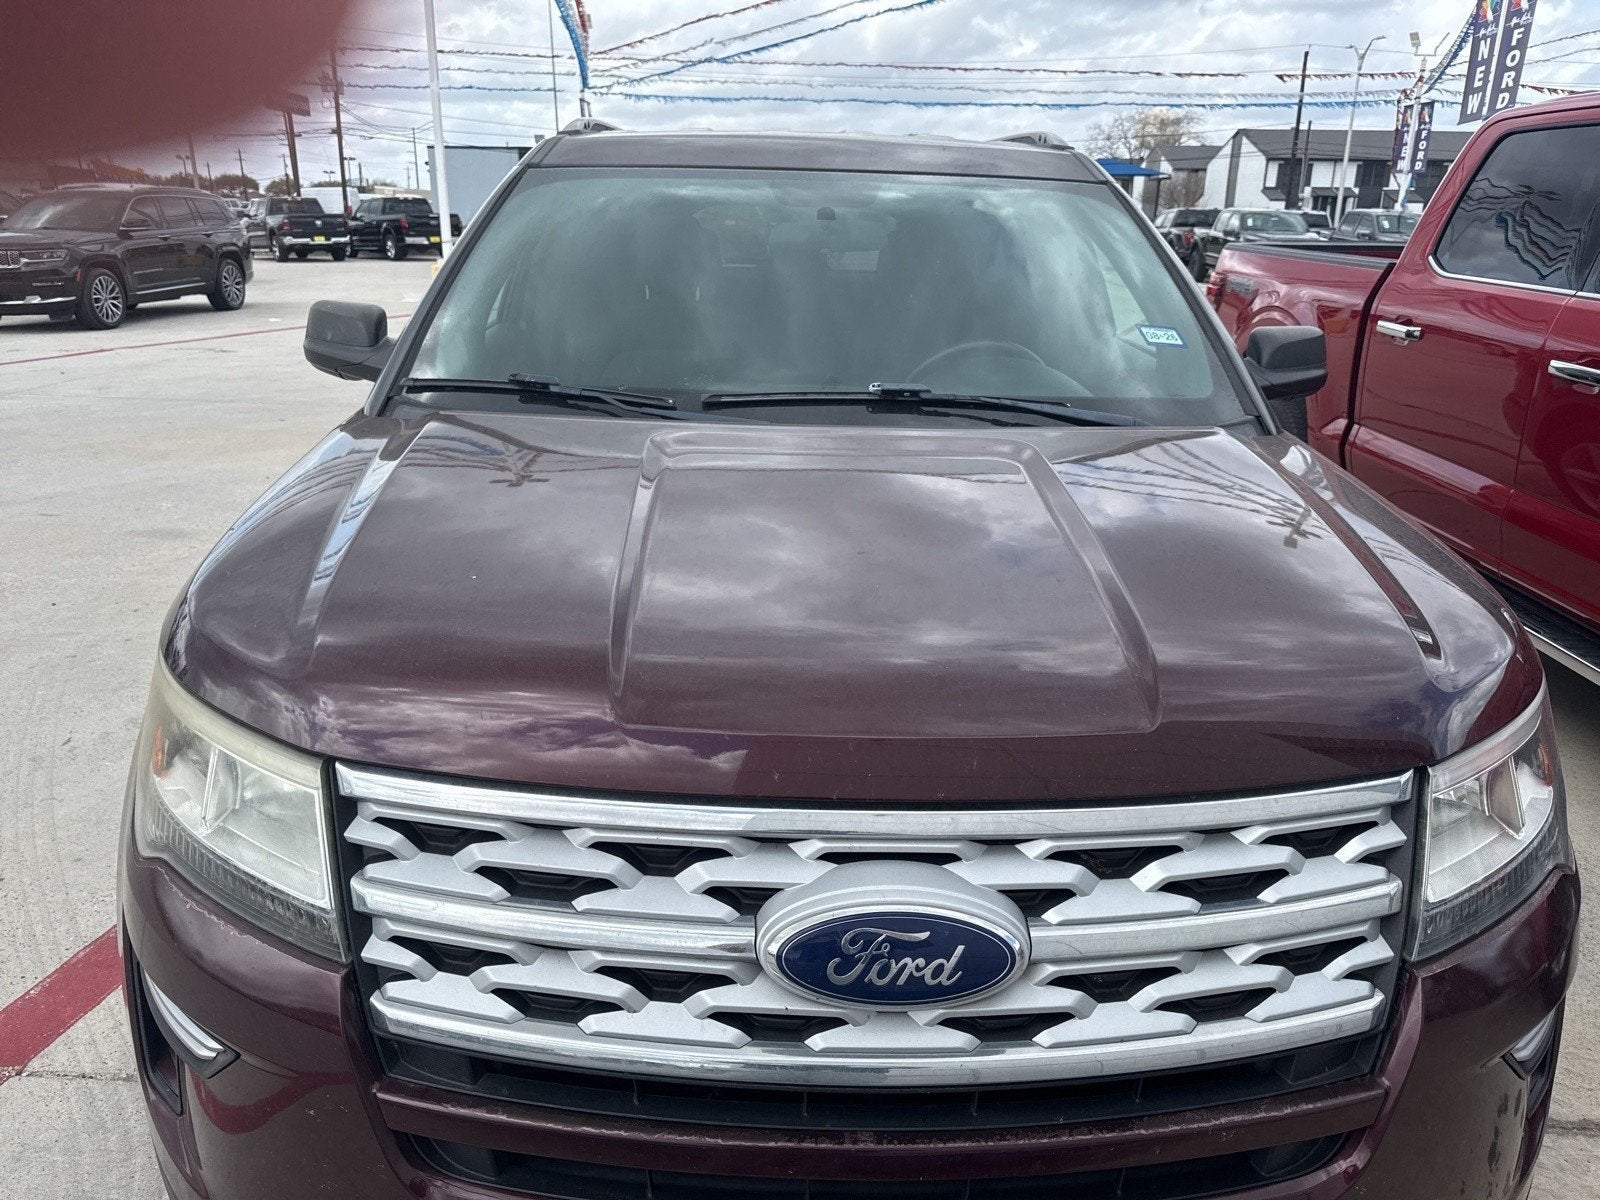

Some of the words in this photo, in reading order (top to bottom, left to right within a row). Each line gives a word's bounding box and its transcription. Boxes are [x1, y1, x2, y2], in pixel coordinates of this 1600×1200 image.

[1466, 37, 1491, 115] NEW
[1495, 27, 1525, 109] FORD
[1414, 130, 1428, 170] FORD
[826, 927, 966, 986] Ford
